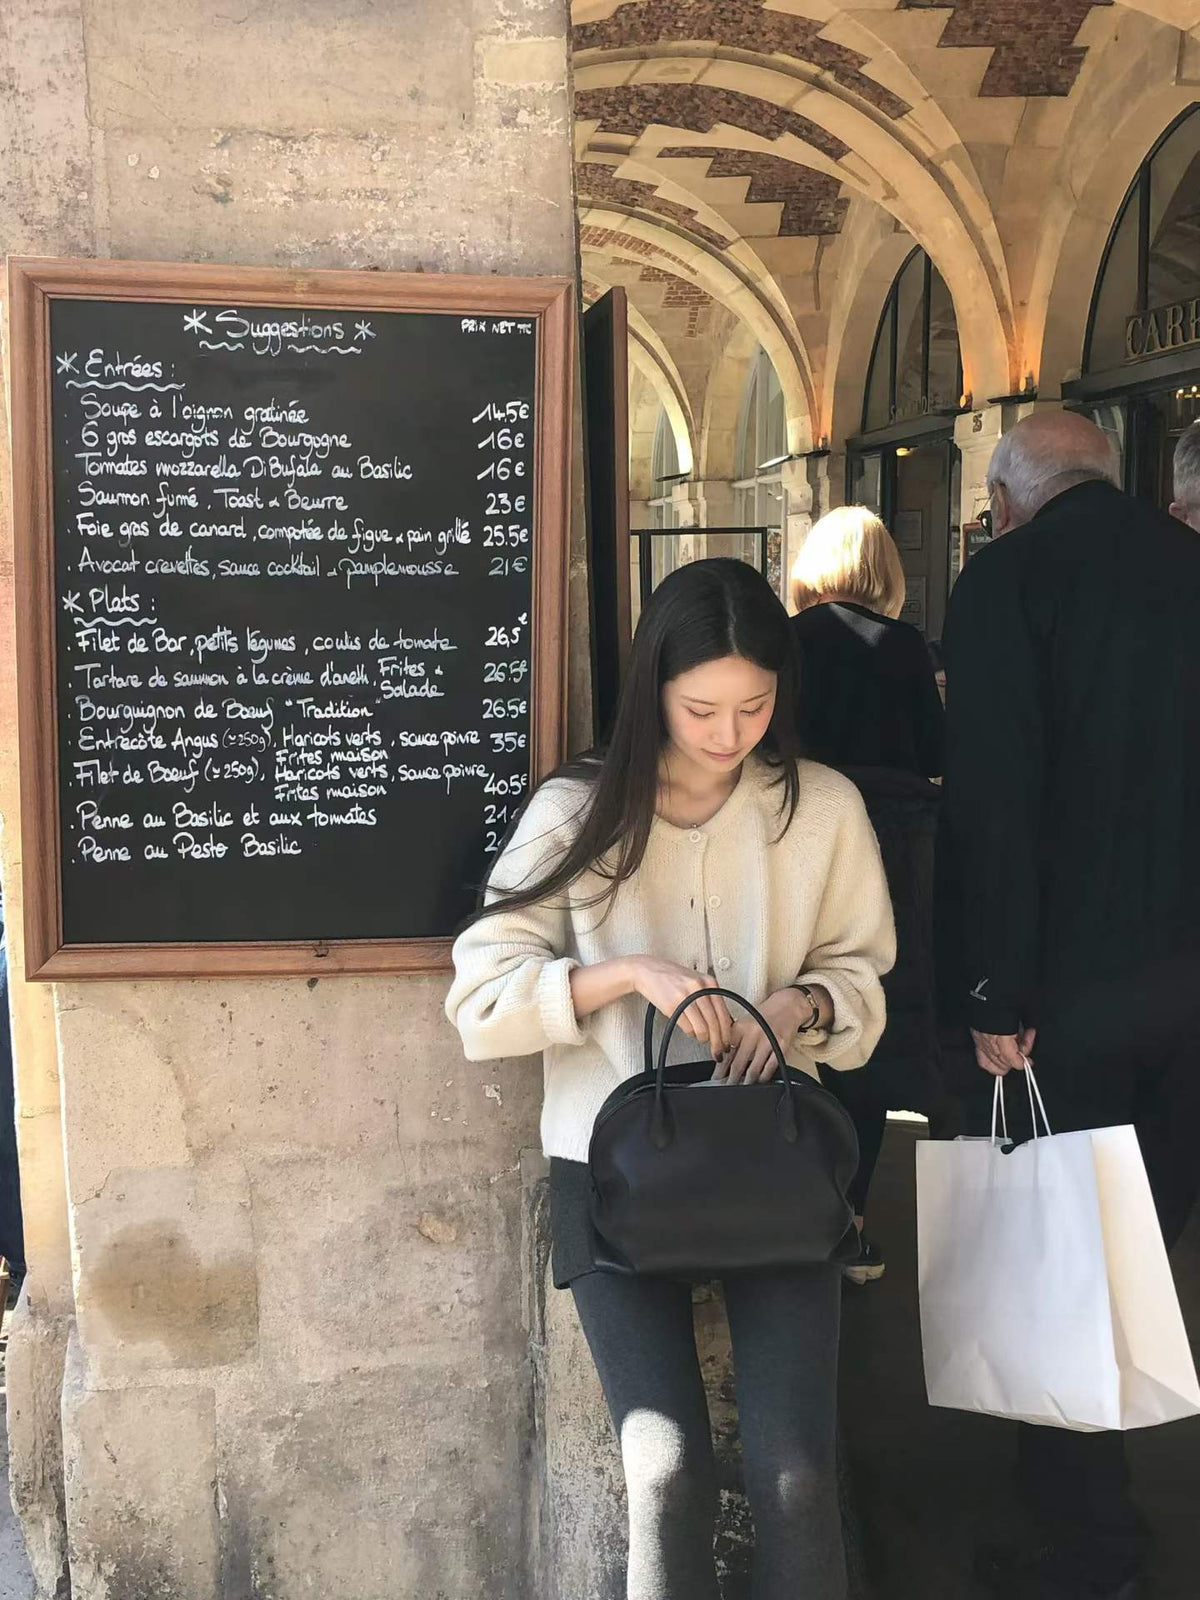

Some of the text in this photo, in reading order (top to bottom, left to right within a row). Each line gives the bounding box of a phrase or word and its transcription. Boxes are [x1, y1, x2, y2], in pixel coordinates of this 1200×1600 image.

[215, 310, 344, 356] Suggestions
[492, 320, 516, 334] NET
[85, 349, 163, 378] Entrées
[80, 393, 142, 426] Soupe
[149, 399, 162, 418] à
[172, 394, 233, 433] l'oignon
[244, 398, 310, 435] gratinée
[81, 421, 525, 459] 6 gros escargots de Bourgogne 16€
[75, 452, 148, 476] Tomates
[156, 454, 242, 479] mozzarella
[331, 464, 352, 479] au
[357, 455, 413, 480] Basilic
[477, 458, 526, 480] 16€
[78, 481, 150, 507] Saumon
[213, 487, 264, 509] Toast
[284, 487, 349, 511] Beurre
[485, 492, 526, 515] 23€
[76, 511, 114, 538] Foie
[119, 521, 149, 548] gras
[159, 513, 183, 537] de
[258, 518, 324, 549] compotée
[328, 520, 348, 541] de
[348, 517, 393, 554] figue
[406, 525, 432, 552] pain
[434, 517, 472, 555] grillé
[482, 524, 529, 548] 25.5€
[78, 546, 140, 574] Avocat
[218, 559, 261, 577] sauce
[267, 551, 320, 577] cocktail
[338, 553, 459, 590] pamplemousse
[488, 557, 528, 577] 21€
[89, 584, 140, 613] Plats
[75, 628, 120, 653] Filet
[127, 632, 149, 653] de
[194, 625, 238, 664] petits
[312, 630, 362, 651] coulis
[368, 628, 390, 650] de
[393, 627, 458, 651] tomate
[74, 662, 143, 688] Tartare
[149, 665, 168, 687] de
[173, 671, 229, 687] saumon
[236, 665, 248, 686] à
[252, 664, 269, 686] la
[272, 666, 314, 686] crème
[378, 655, 425, 678] Frites
[380, 677, 445, 700] Salade
[75, 694, 186, 735] Bourguignon
[195, 697, 218, 719] de
[482, 698, 528, 720] 26.5€
[78, 726, 166, 750] Entrecôte
[171, 727, 219, 758] Angus
[283, 723, 341, 747] Haricots
[400, 730, 440, 746] sauce
[440, 730, 480, 757] poivre
[490, 731, 526, 753] 35€
[276, 747, 389, 766] Frites maison
[72, 758, 119, 788] Filet
[123, 763, 144, 784] de
[274, 764, 341, 782] Haricots
[442, 762, 489, 795] poivre
[484, 773, 528, 795] 40.5€
[274, 783, 387, 802] Frites maison
[76, 801, 134, 830] Penne
[143, 814, 166, 829] au
[172, 801, 234, 828] Basilic
[242, 803, 260, 826] et
[269, 811, 303, 827] aux
[306, 803, 377, 828] tomates
[77, 835, 132, 862] Penne
[144, 845, 168, 860] au
[172, 831, 229, 859] Pesto
[240, 832, 302, 858] Basilic
